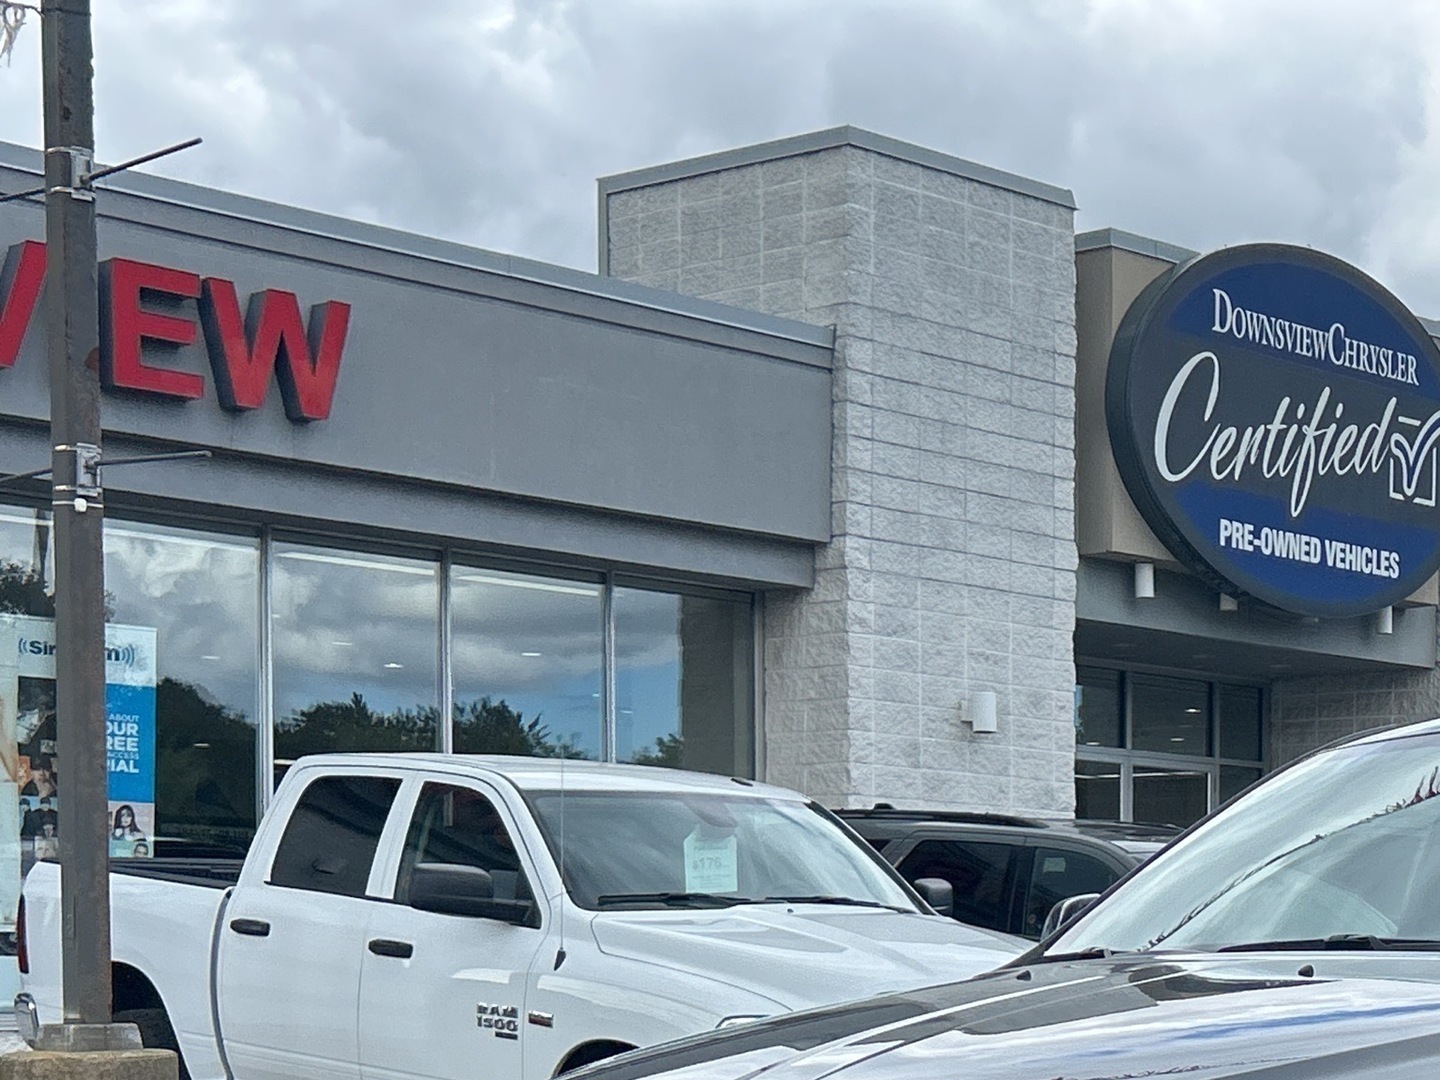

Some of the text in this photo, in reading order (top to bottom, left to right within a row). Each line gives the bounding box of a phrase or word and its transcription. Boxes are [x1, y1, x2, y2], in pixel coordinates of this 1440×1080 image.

[1154, 351, 1397, 517] Certified
[1219, 518, 1400, 578] PRE-OWNED VEHICLES
[109, 713, 139, 723] ABOUT
[106, 721, 139, 736] OUR
[106, 735, 139, 752] REE
[107, 759, 139, 774] IAL
[477, 1002, 519, 1018] RAM
[477, 1015, 519, 1032] 1500
